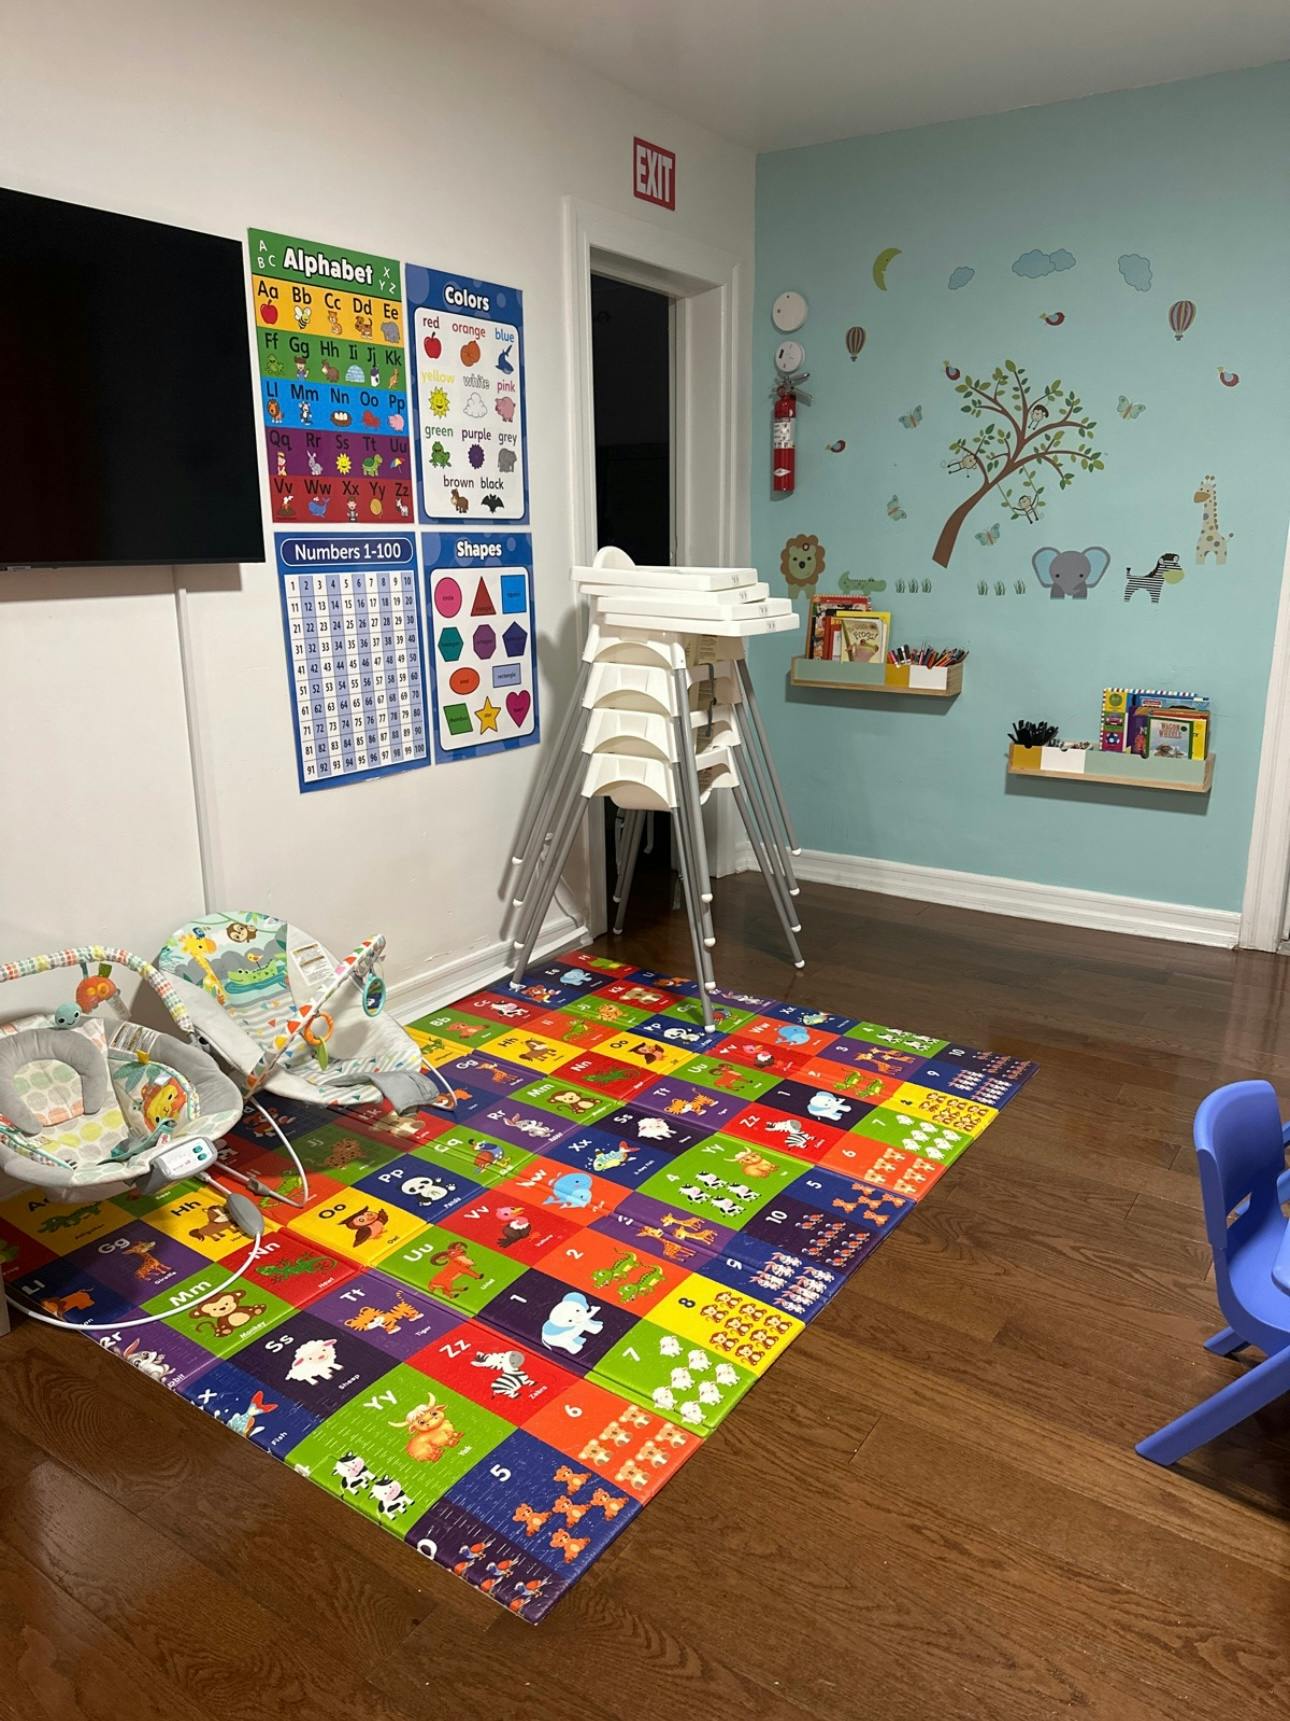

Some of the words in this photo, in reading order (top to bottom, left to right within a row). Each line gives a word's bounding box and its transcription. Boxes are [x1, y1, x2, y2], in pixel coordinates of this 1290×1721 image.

[636, 144, 673, 203] EXIT
[259, 240, 267, 252] A
[257, 257, 265, 268] B
[269, 255, 276, 266] C
[284, 247, 373, 285] Alphabet
[383, 267, 391, 277] X
[378, 280, 385, 291] Y
[388, 282, 396, 294] Z
[257, 280, 278, 299] Aa
[292, 287, 312, 304] Bb
[324, 293, 341, 310] Cc
[353, 298, 372, 315] Dd
[384, 304, 398, 319] Ee
[445, 285, 490, 311] Colors
[423, 316, 440, 329] red
[452, 323, 486, 339] orange
[495, 328, 515, 342] blue
[265, 333, 279, 350] Ff
[289, 337, 310, 358] Gg
[320, 341, 340, 357] Hh
[349, 345, 358, 360] Ii
[367, 348, 377, 369] Jj
[385, 350, 401, 366] Kk
[421, 371, 455, 384] yellow
[463, 374, 490, 389] white
[497, 381, 516, 393] pink
[266, 382, 278, 398] Ll
[291, 384, 319, 401] Mm
[331, 388, 349, 403] Nn
[360, 392, 379, 406] Oo
[389, 395, 405, 415] Pp
[425, 425, 454, 438] green
[462, 428, 491, 441] purple
[270, 430, 290, 451] Qq
[306, 433, 320, 447] Rr
[336, 435, 349, 449] Ss
[363, 437, 376, 451] Tt
[390, 439, 407, 453] Uu
[498, 433, 517, 445] grey
[274, 478, 293, 494] Vv
[304, 480, 331, 494] Ww
[342, 481, 359, 495] Xx
[370, 483, 385, 499] Yy
[395, 483, 409, 497] Zz
[443, 478, 474, 489] brown
[480, 478, 504, 490] black
[295, 544, 360, 560] Numbers
[364, 543, 401, 559] 1-100
[457, 541, 502, 558] Shapes
[291, 581, 295, 591] 1
[304, 580, 309, 591] 2
[317, 580, 323, 590] 3
[331, 579, 336, 588] 4
[344, 578, 349, 589] 5
[356, 578, 362, 588] 6
[369, 577, 374, 587] 7
[381, 577, 386, 587] 8
[393, 577, 398, 586] 9
[403, 576, 412, 585] 10
[291, 602, 300, 613] 11
[304, 601, 313, 612] 12
[318, 601, 326, 611] 13
[331, 600, 340, 610] 14
[344, 599, 352, 609] 15
[357, 599, 365, 608] 16
[369, 598, 377, 607] 17
[381, 597, 389, 607] 18
[393, 596, 401, 606] 19
[405, 596, 413, 605] 20
[293, 623, 301, 634] 21
[306, 622, 315, 633] 22
[319, 621, 328, 632] 23
[332, 621, 341, 631] 24
[346, 619, 354, 630] 25
[358, 619, 367, 629] 26
[371, 617, 378, 628] 27
[383, 617, 391, 626] 28
[395, 616, 402, 625] 29
[406, 615, 415, 625] 30
[498, 1038, 518, 1047] Hh
[610, 1040, 629, 1049] Oo
[949, 1048, 966, 1057] 10
[570, 1060, 592, 1072] Nn
[688, 1063, 708, 1073] Uu
[527, 1084, 555, 1097] Mm
[653, 1087, 671, 1097] Tt
[613, 1114, 633, 1124] Ss
[740, 1116, 760, 1128] Zz
[871, 1118, 886, 1127] 7
[568, 1139, 592, 1152] Xx
[702, 1144, 725, 1154] Yy
[842, 1149, 857, 1158] 6
[378, 1169, 404, 1183] Pp
[666, 1172, 681, 1183] 4
[806, 1179, 823, 1190] 5
[171, 1200, 202, 1216] Hh
[318, 1204, 346, 1219] Oo
[464, 1205, 489, 1219] Vv
[766, 1210, 788, 1224] 10
[98, 1238, 130, 1254] Gg
[403, 1243, 434, 1262] Uu
[566, 1249, 584, 1259] 2
[726, 1259, 743, 1270] 9
[22, 1280, 45, 1295] Ll
[169, 1280, 212, 1307] Mm
[339, 1288, 366, 1303] Tt
[510, 1294, 527, 1304] 1
[678, 1297, 696, 1309] 8
[239, 1320, 267, 1340] Monkey
[264, 1334, 295, 1353] Ss
[438, 1338, 471, 1359] Zz
[622, 1346, 641, 1362] 7
[338, 1373, 360, 1391] Sheep
[528, 1384, 548, 1400] Zebra
[363, 1390, 398, 1411] Yy
[563, 1404, 583, 1418] 6
[271, 1431, 288, 1447] Fish
[490, 1463, 512, 1482] 5
